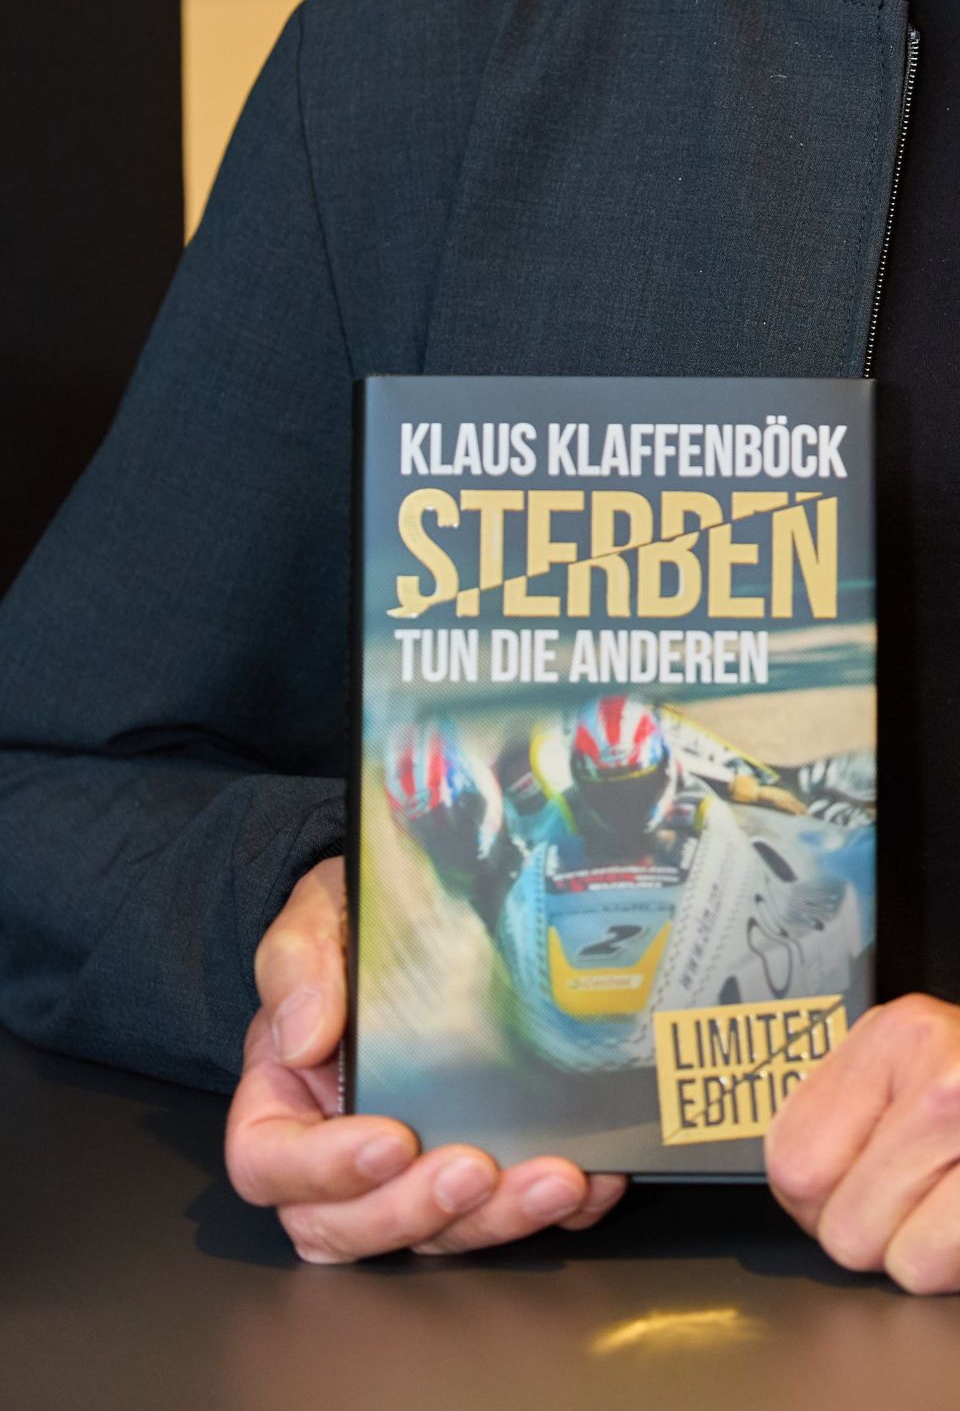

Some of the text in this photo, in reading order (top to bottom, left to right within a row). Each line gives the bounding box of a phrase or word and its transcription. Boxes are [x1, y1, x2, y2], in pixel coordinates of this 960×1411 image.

[400, 415, 848, 477] KLAUS KLAFFENBÖCK
[386, 487, 839, 619] STERBEN
[394, 628, 769, 684] TUN DIE ANDEREN
[671, 1009, 831, 1071] LIMITED
[676, 1070, 803, 1129] EDITI
